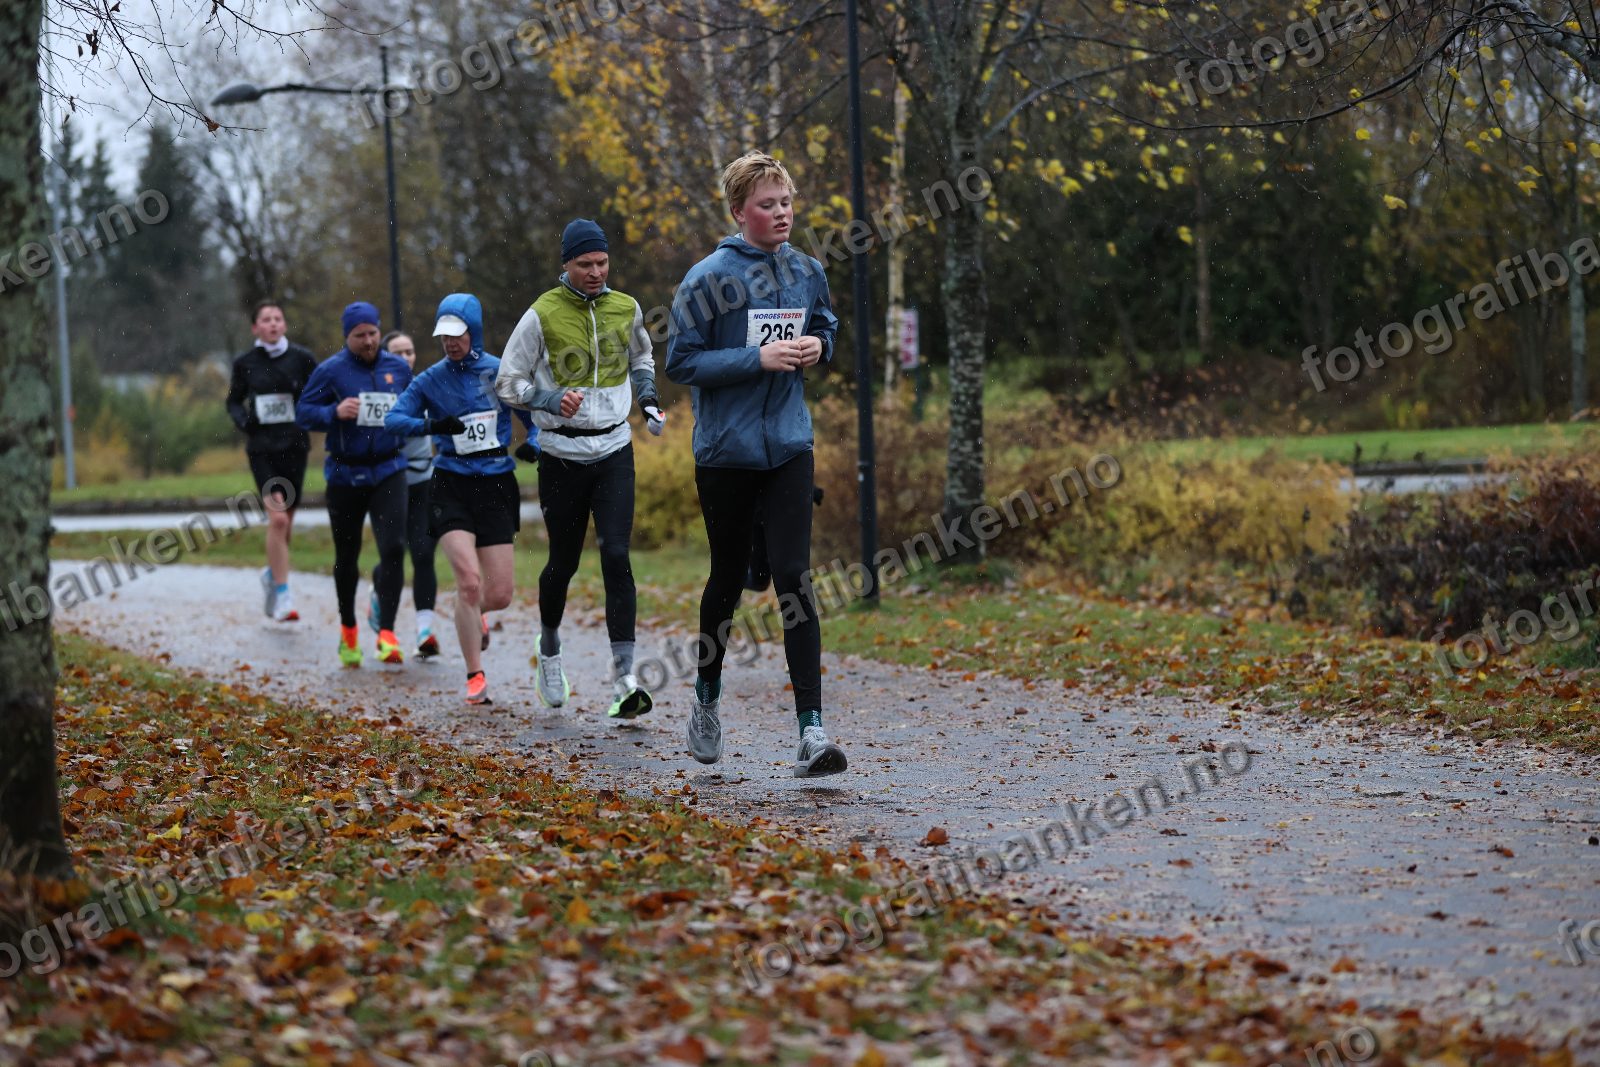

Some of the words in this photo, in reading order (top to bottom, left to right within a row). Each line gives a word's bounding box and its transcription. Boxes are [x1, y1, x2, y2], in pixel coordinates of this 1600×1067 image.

[753, 312, 803, 320] NORGESTESTEN
[760, 323, 795, 347] 236
[468, 423, 486, 442] 49
